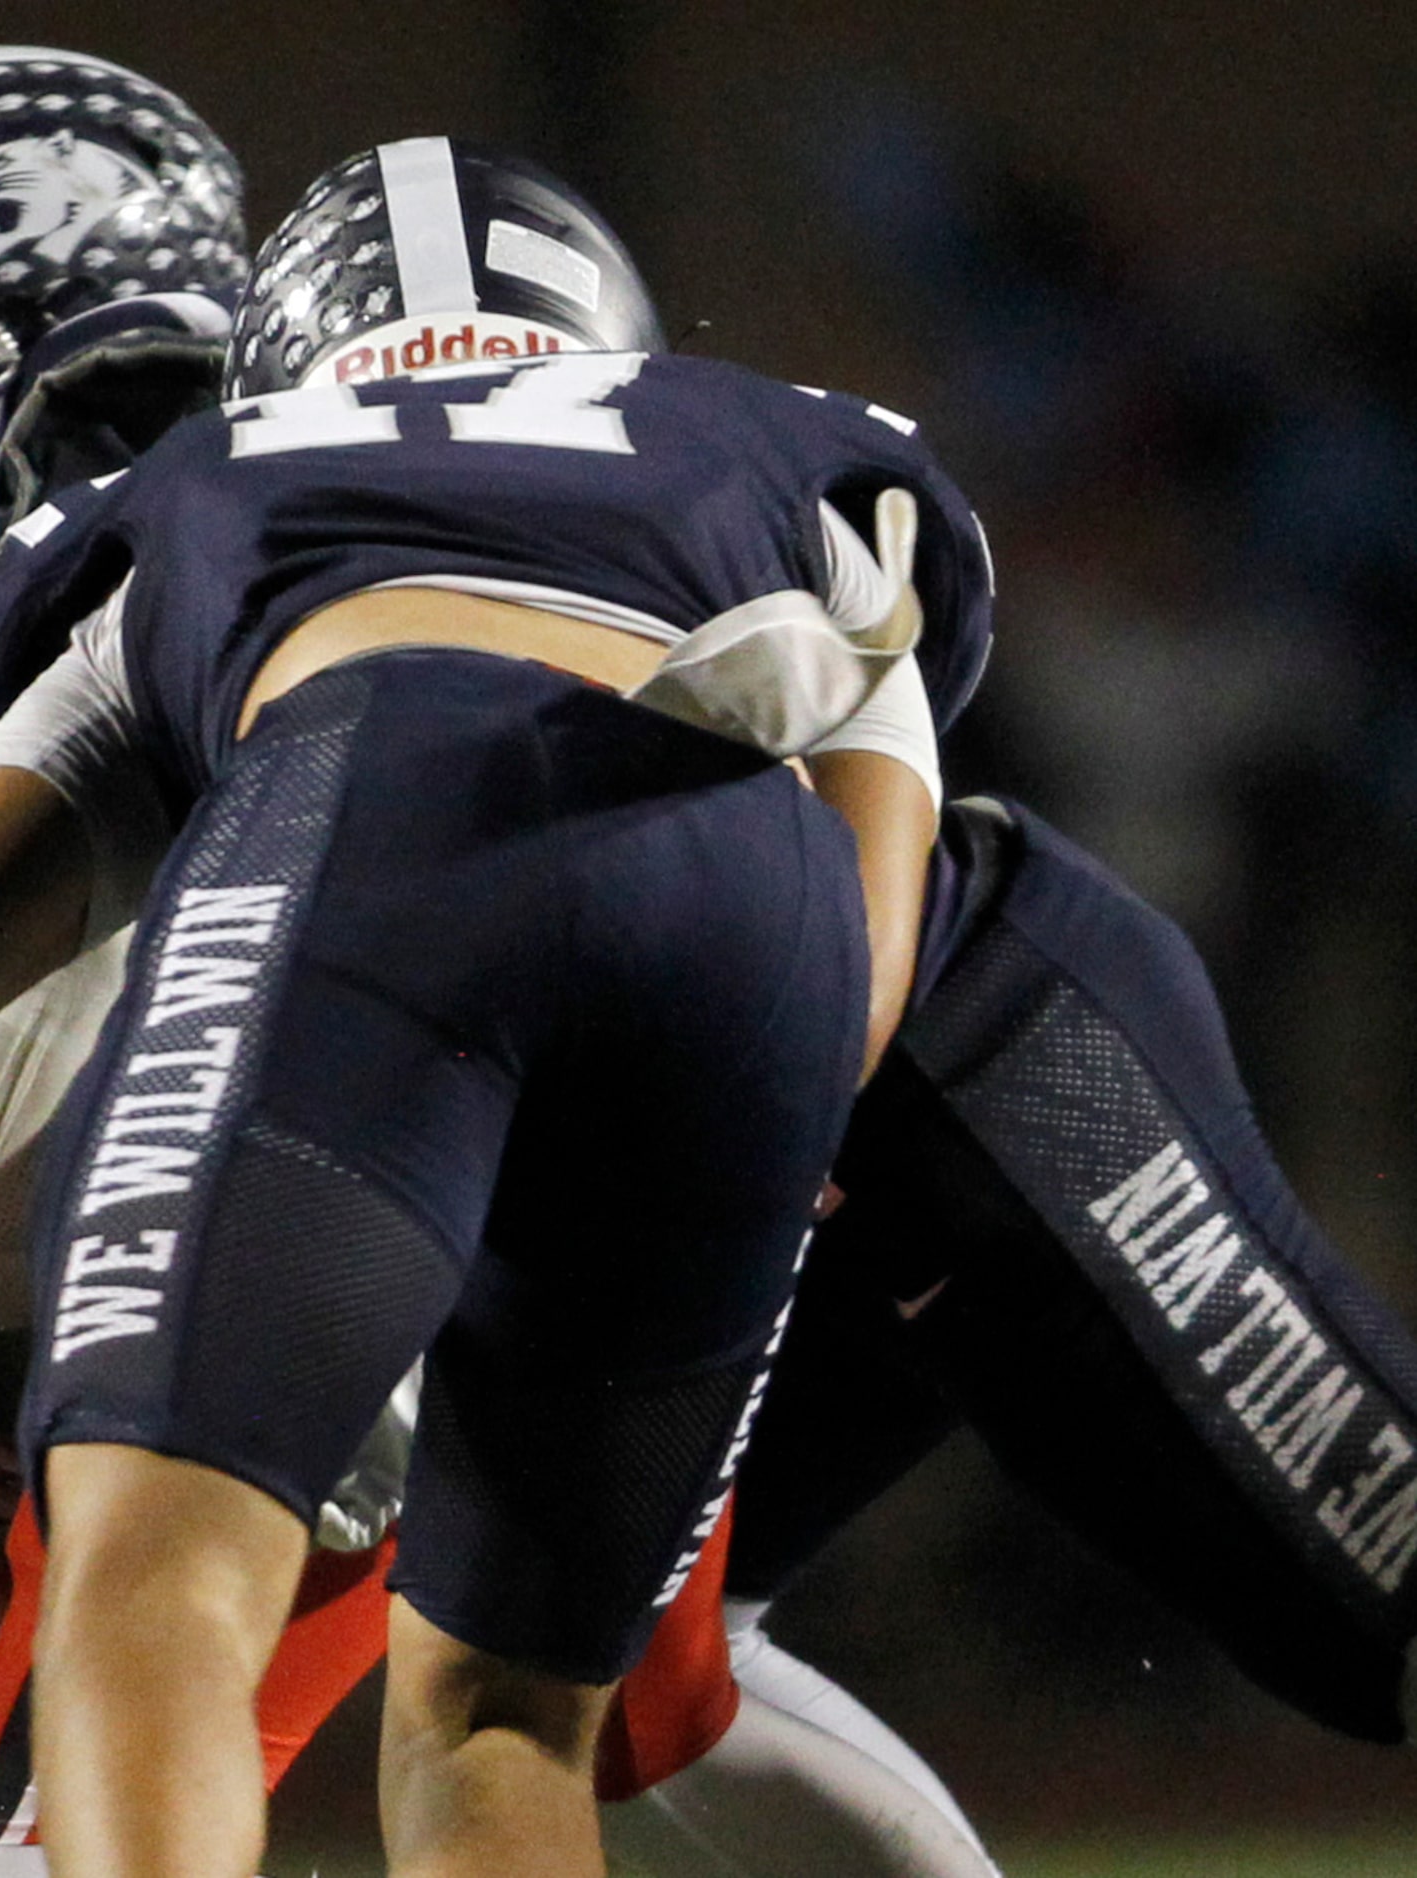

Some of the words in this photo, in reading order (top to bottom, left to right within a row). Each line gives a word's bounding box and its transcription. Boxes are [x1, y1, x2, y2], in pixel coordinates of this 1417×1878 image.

[144, 884, 289, 1028] WIN
[81, 1026, 242, 1217] WILL
[51, 1228, 179, 1363] WE
[1086, 1139, 1242, 1331] WIN
[1197, 1265, 1365, 1491] WILL
[1316, 1423, 1417, 1594] WE
